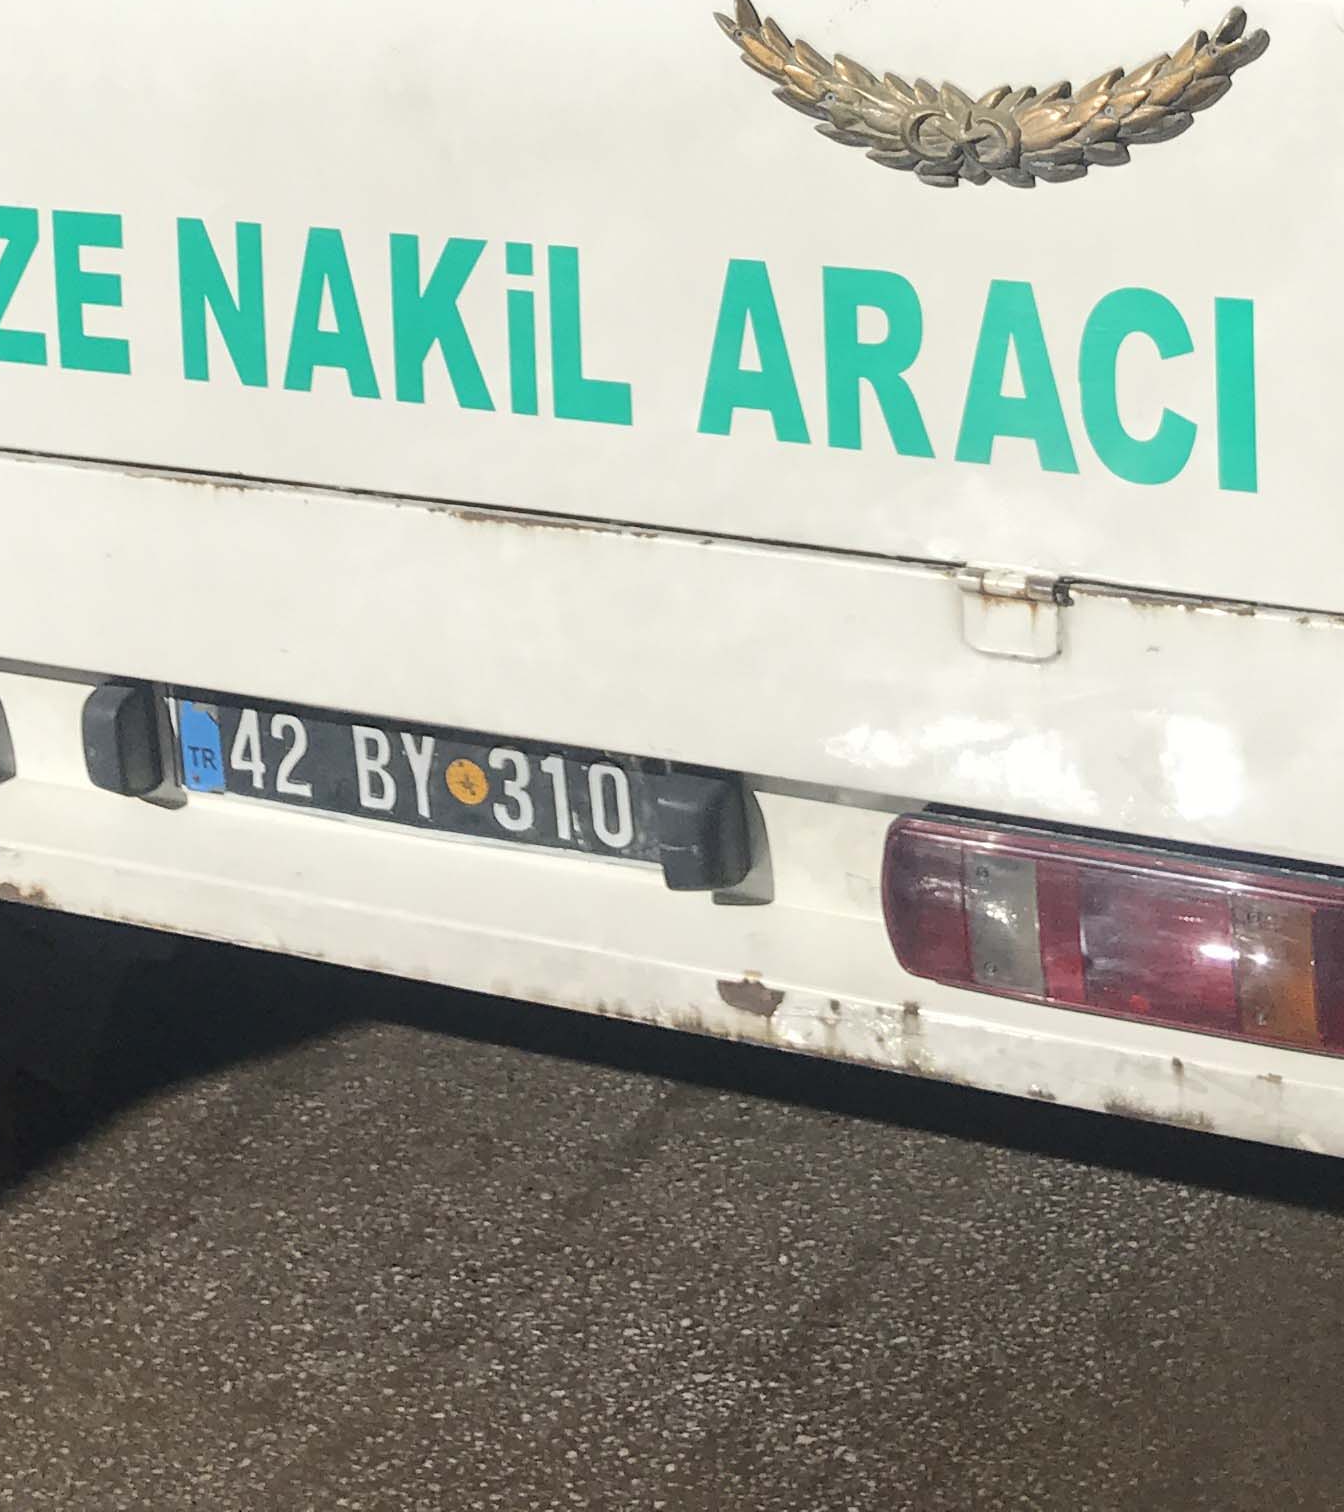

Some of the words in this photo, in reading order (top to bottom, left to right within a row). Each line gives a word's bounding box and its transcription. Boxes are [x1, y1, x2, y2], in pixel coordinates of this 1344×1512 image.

[697, 258, 1259, 494] ARACI
[187, 744, 218, 771] TR
[230, 707, 313, 798] 42
[352, 724, 436, 820] BY
[488, 747, 635, 849] 310
